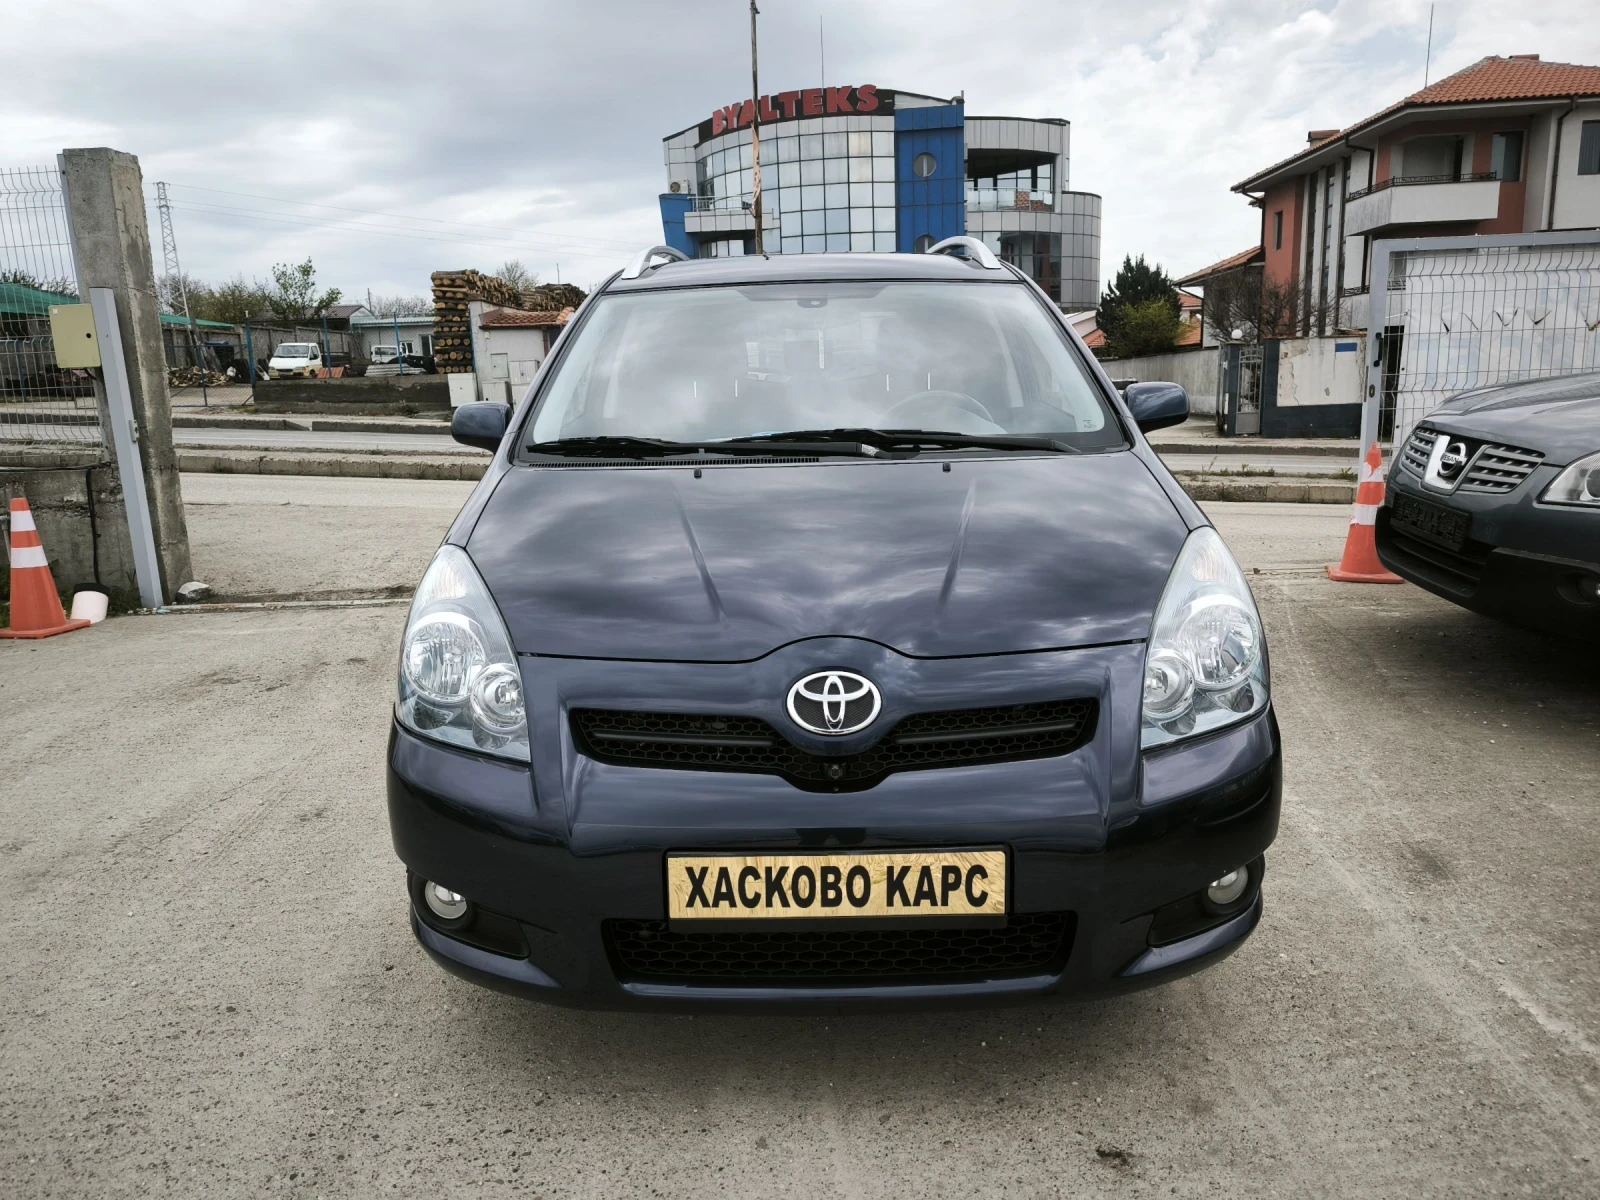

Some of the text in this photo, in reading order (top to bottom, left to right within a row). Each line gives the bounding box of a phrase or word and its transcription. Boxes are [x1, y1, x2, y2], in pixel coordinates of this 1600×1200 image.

[712, 84, 879, 136] BYALTEKS
[685, 864, 989, 908] ХАСКОВО КАРС
